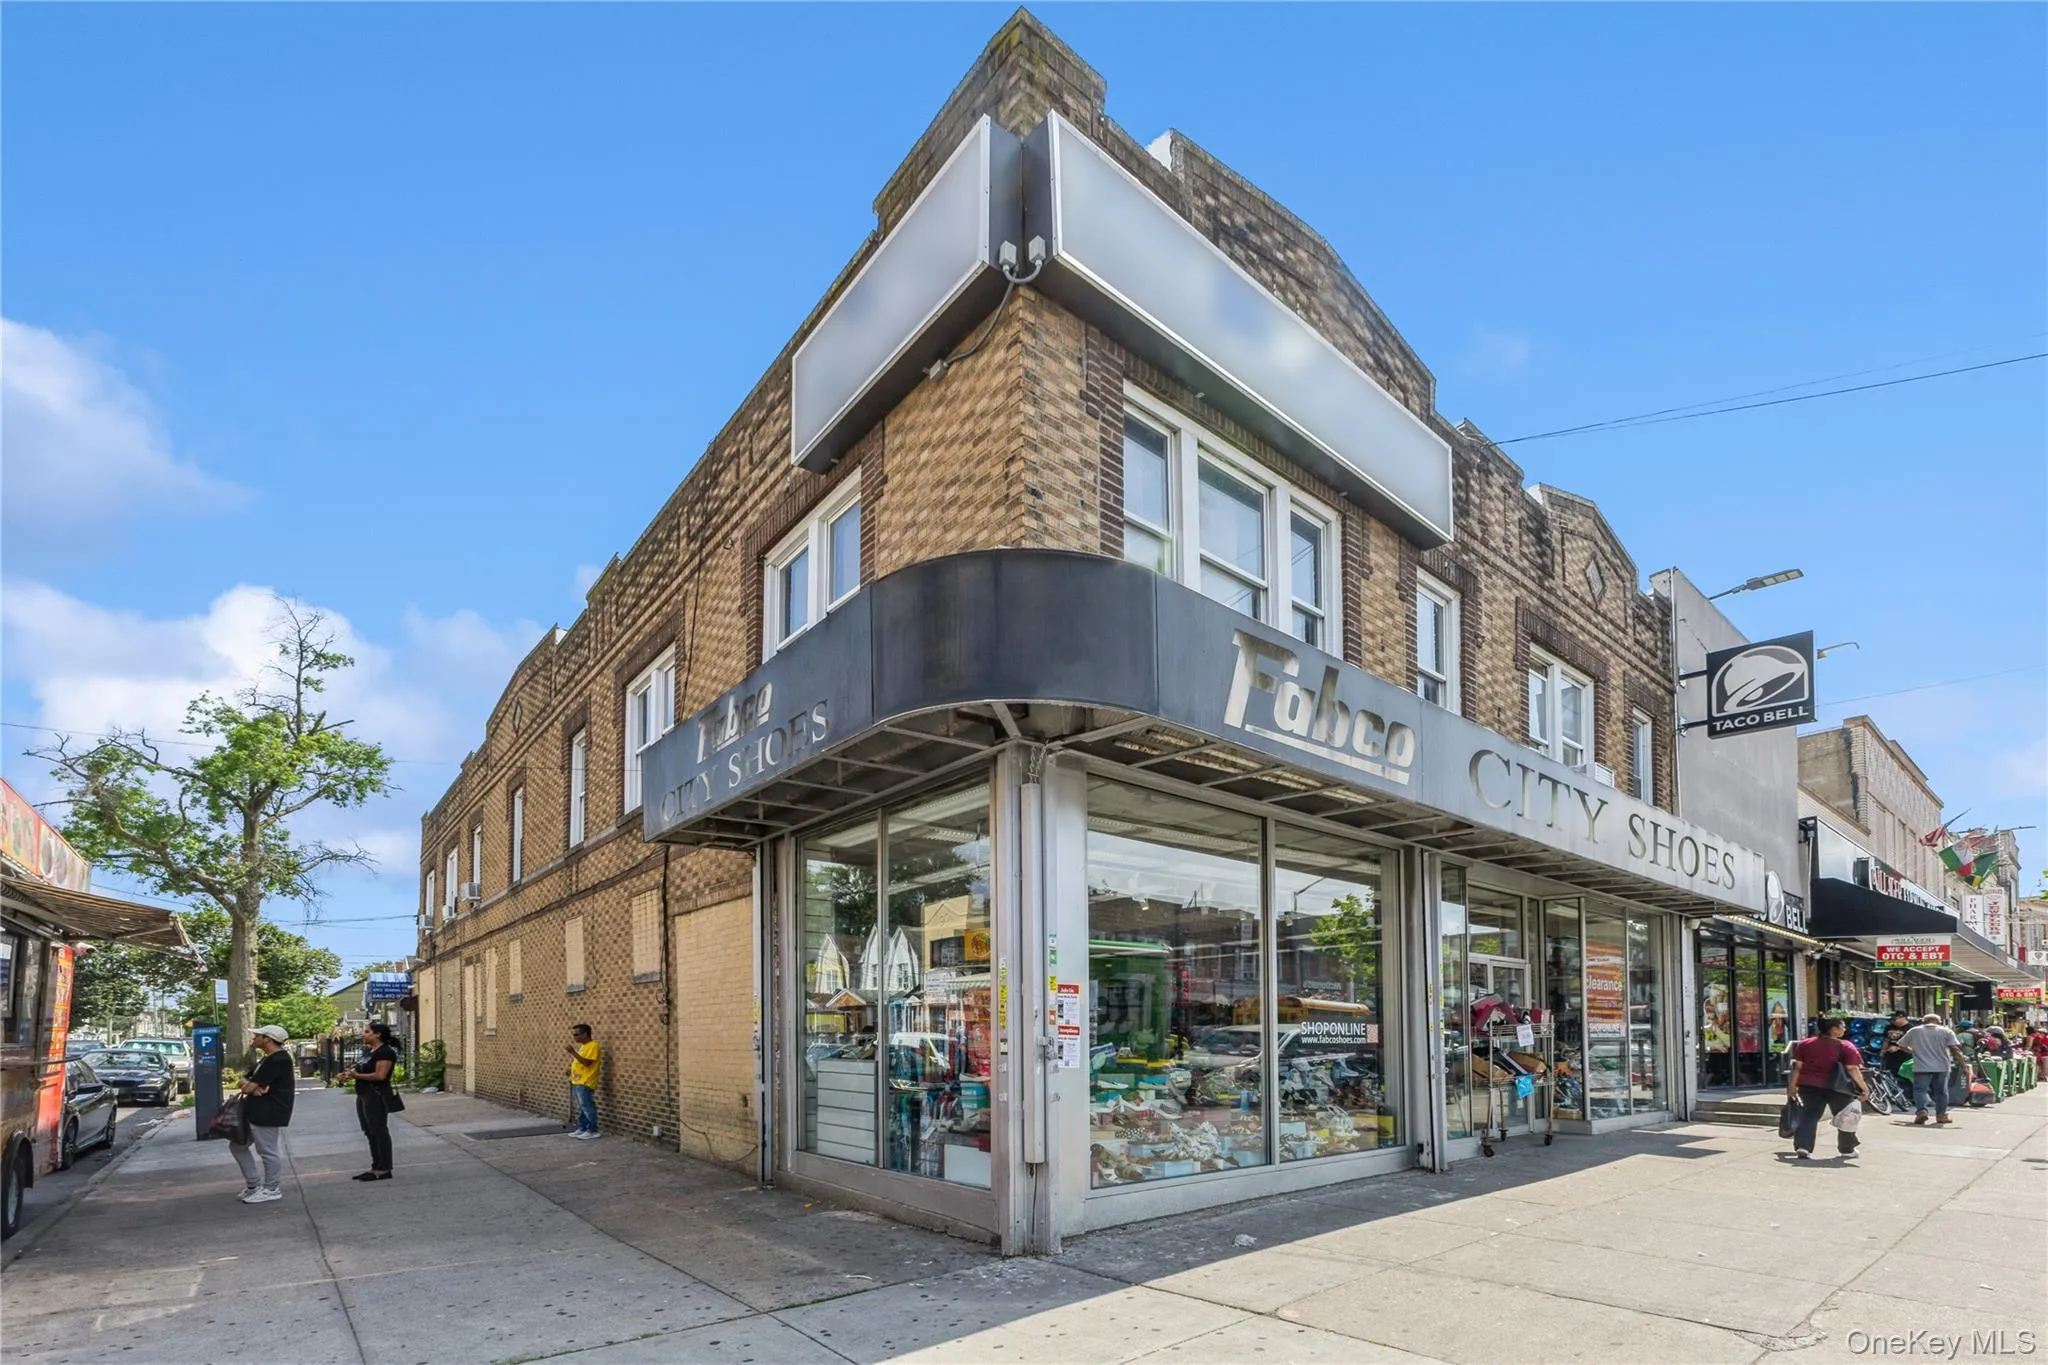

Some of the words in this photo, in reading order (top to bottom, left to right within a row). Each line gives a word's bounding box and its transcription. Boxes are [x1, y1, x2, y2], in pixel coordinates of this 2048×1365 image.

[1224, 629, 1415, 768] Fabco
[1712, 714, 1760, 731] TACO
[1763, 706, 1809, 723] BELL
[661, 763, 717, 822] CITY
[728, 699, 829, 789] SHOES
[1469, 749, 1609, 845] CITY
[1628, 812, 1737, 891] SHOES
[1785, 904, 1808, 934] BELL
[1882, 952, 1904, 960] OTC
[1908, 952, 1917, 960] &
[1921, 952, 1944, 960] EBT
[1301, 1021, 1366, 1036] SHOPONLINE
[1301, 1035, 1367, 1044] www.fabcoshoes.com
[201, 1036, 212, 1047] P
